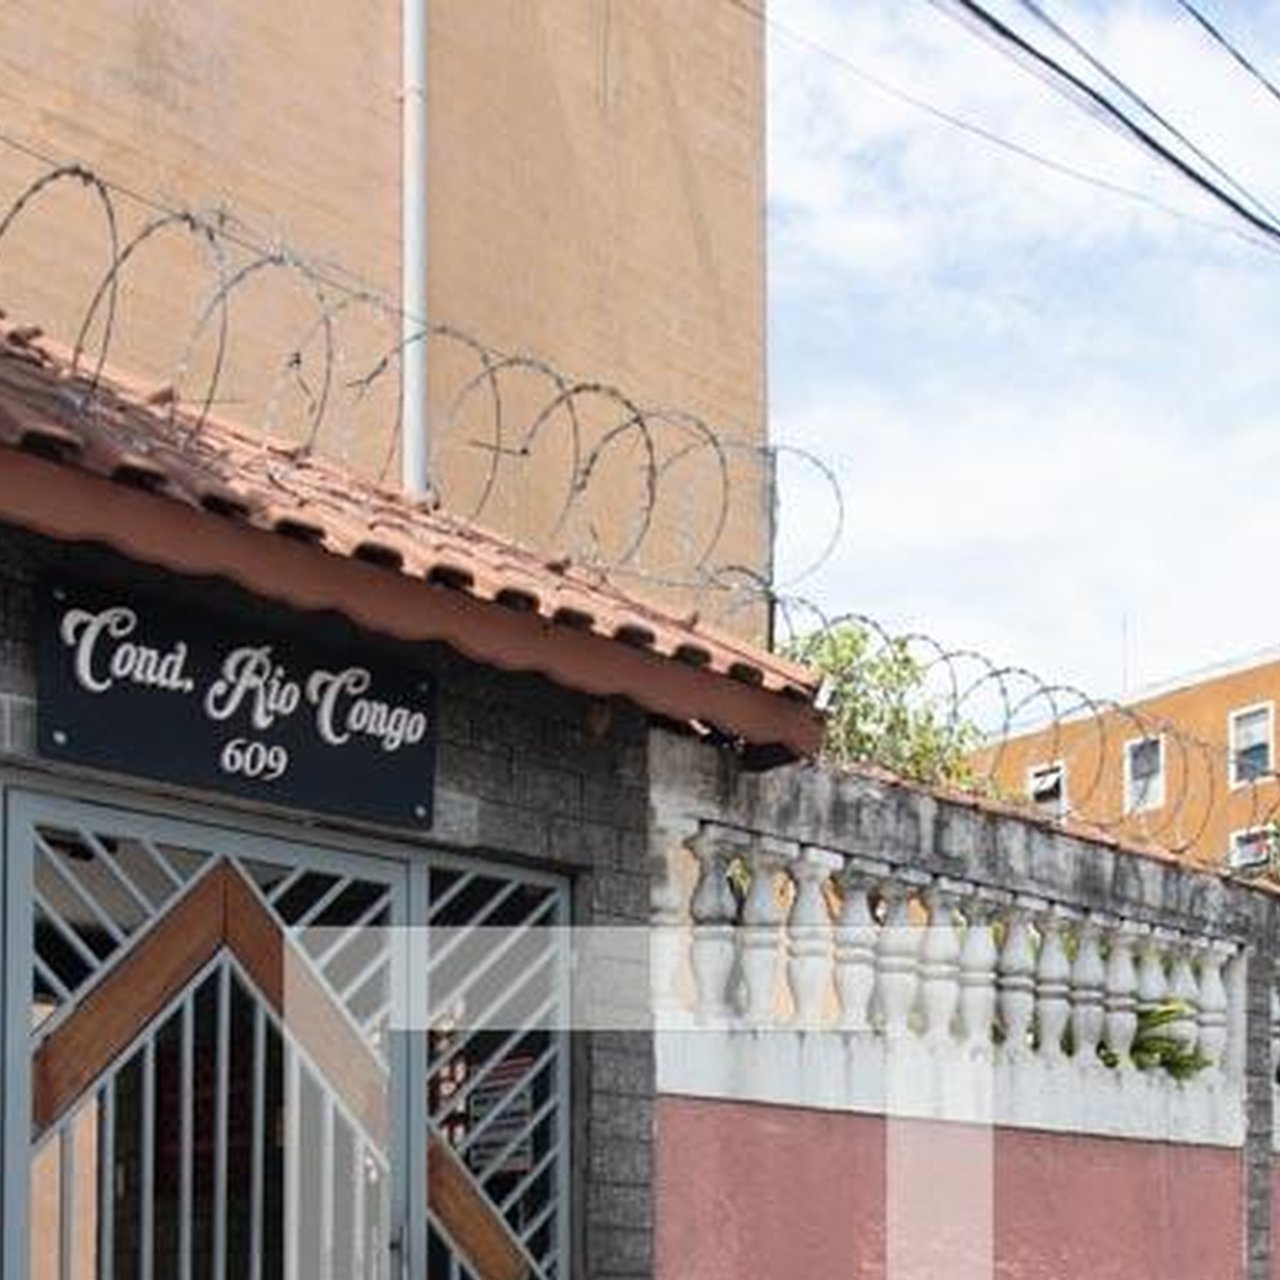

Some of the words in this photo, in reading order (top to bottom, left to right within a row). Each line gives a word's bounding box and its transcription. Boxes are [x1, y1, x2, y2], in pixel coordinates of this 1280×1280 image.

[60, 607, 194, 692] Cond.
[204, 646, 300, 729] Rio
[306, 668, 427, 751] Congo
[221, 738, 288, 781] 609
